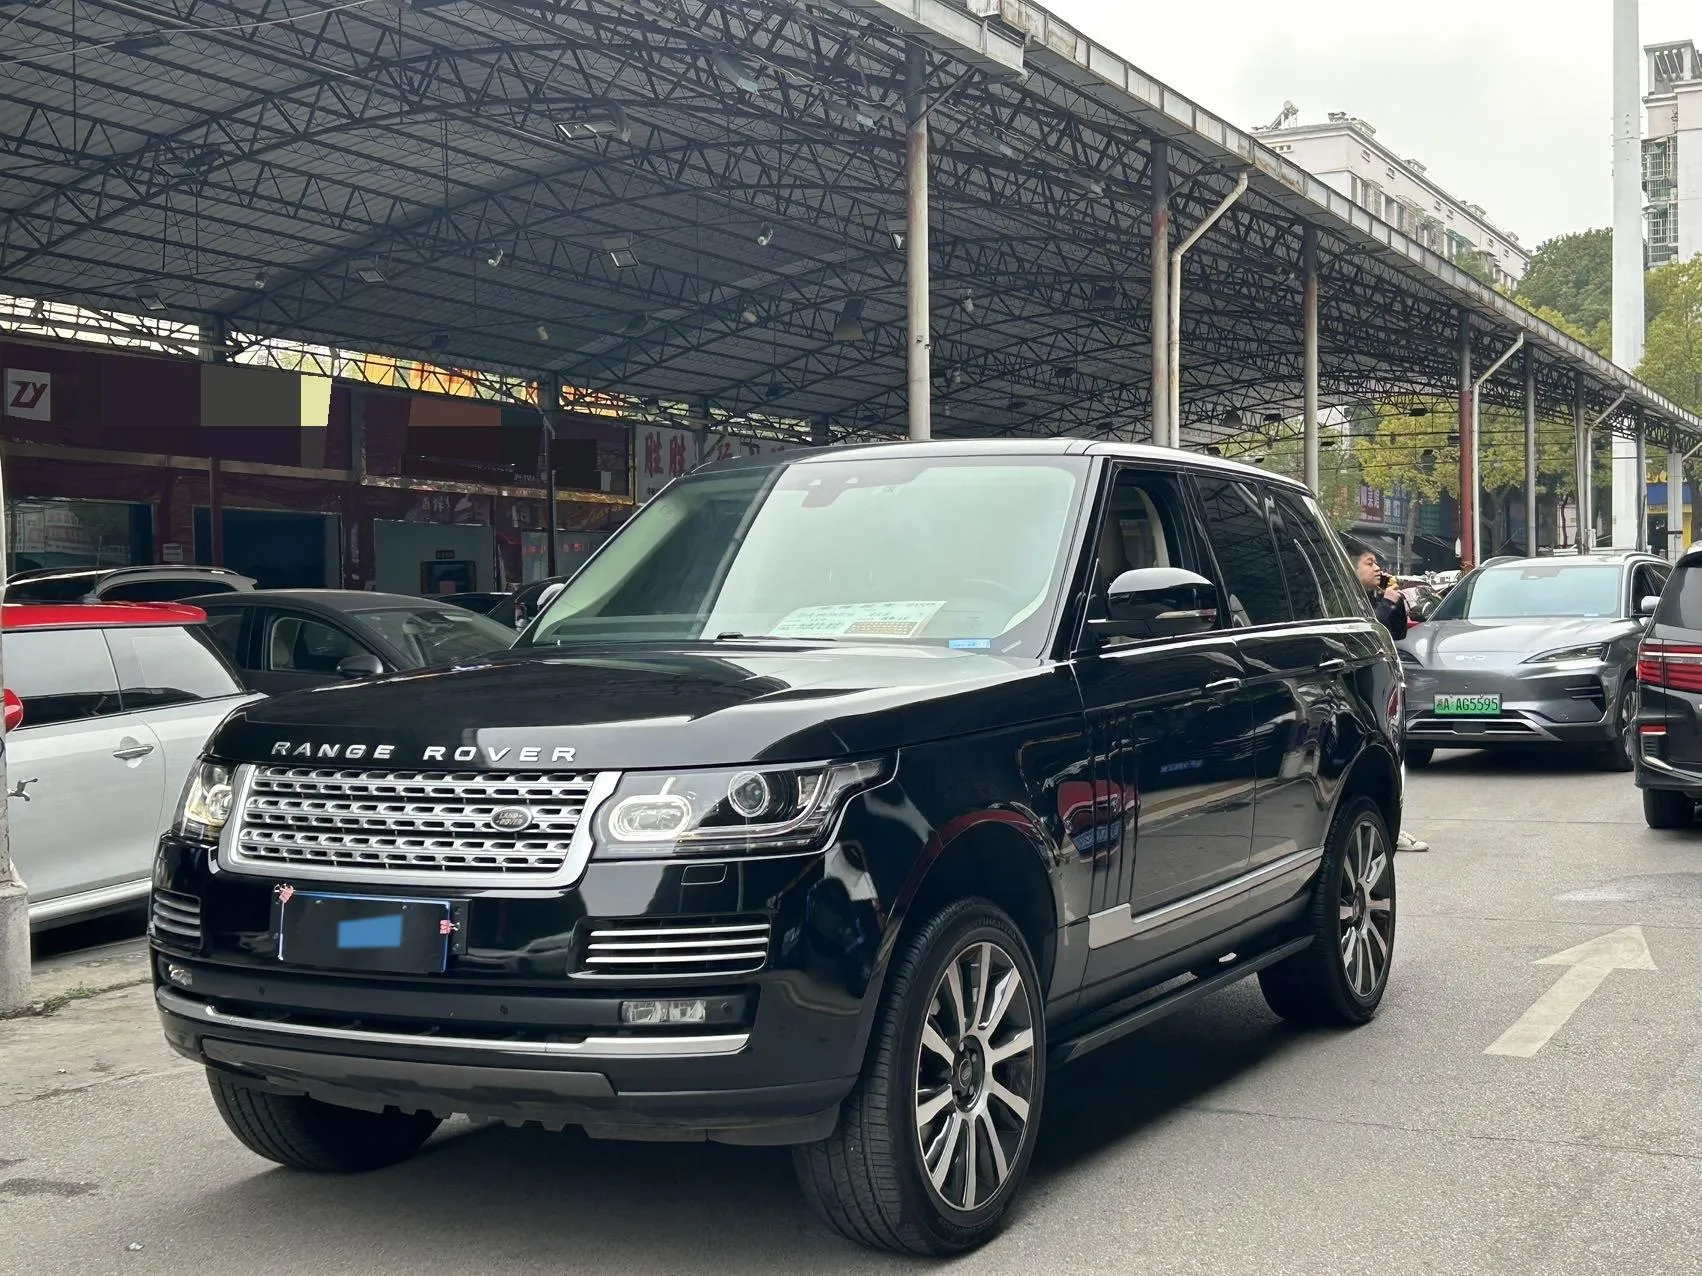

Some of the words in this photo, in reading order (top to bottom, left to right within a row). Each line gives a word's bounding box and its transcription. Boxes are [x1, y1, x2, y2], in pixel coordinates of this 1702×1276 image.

[1456, 697, 1498, 711] AG5595
[271, 741, 395, 759] RANGE
[423, 745, 577, 763] ROVER
